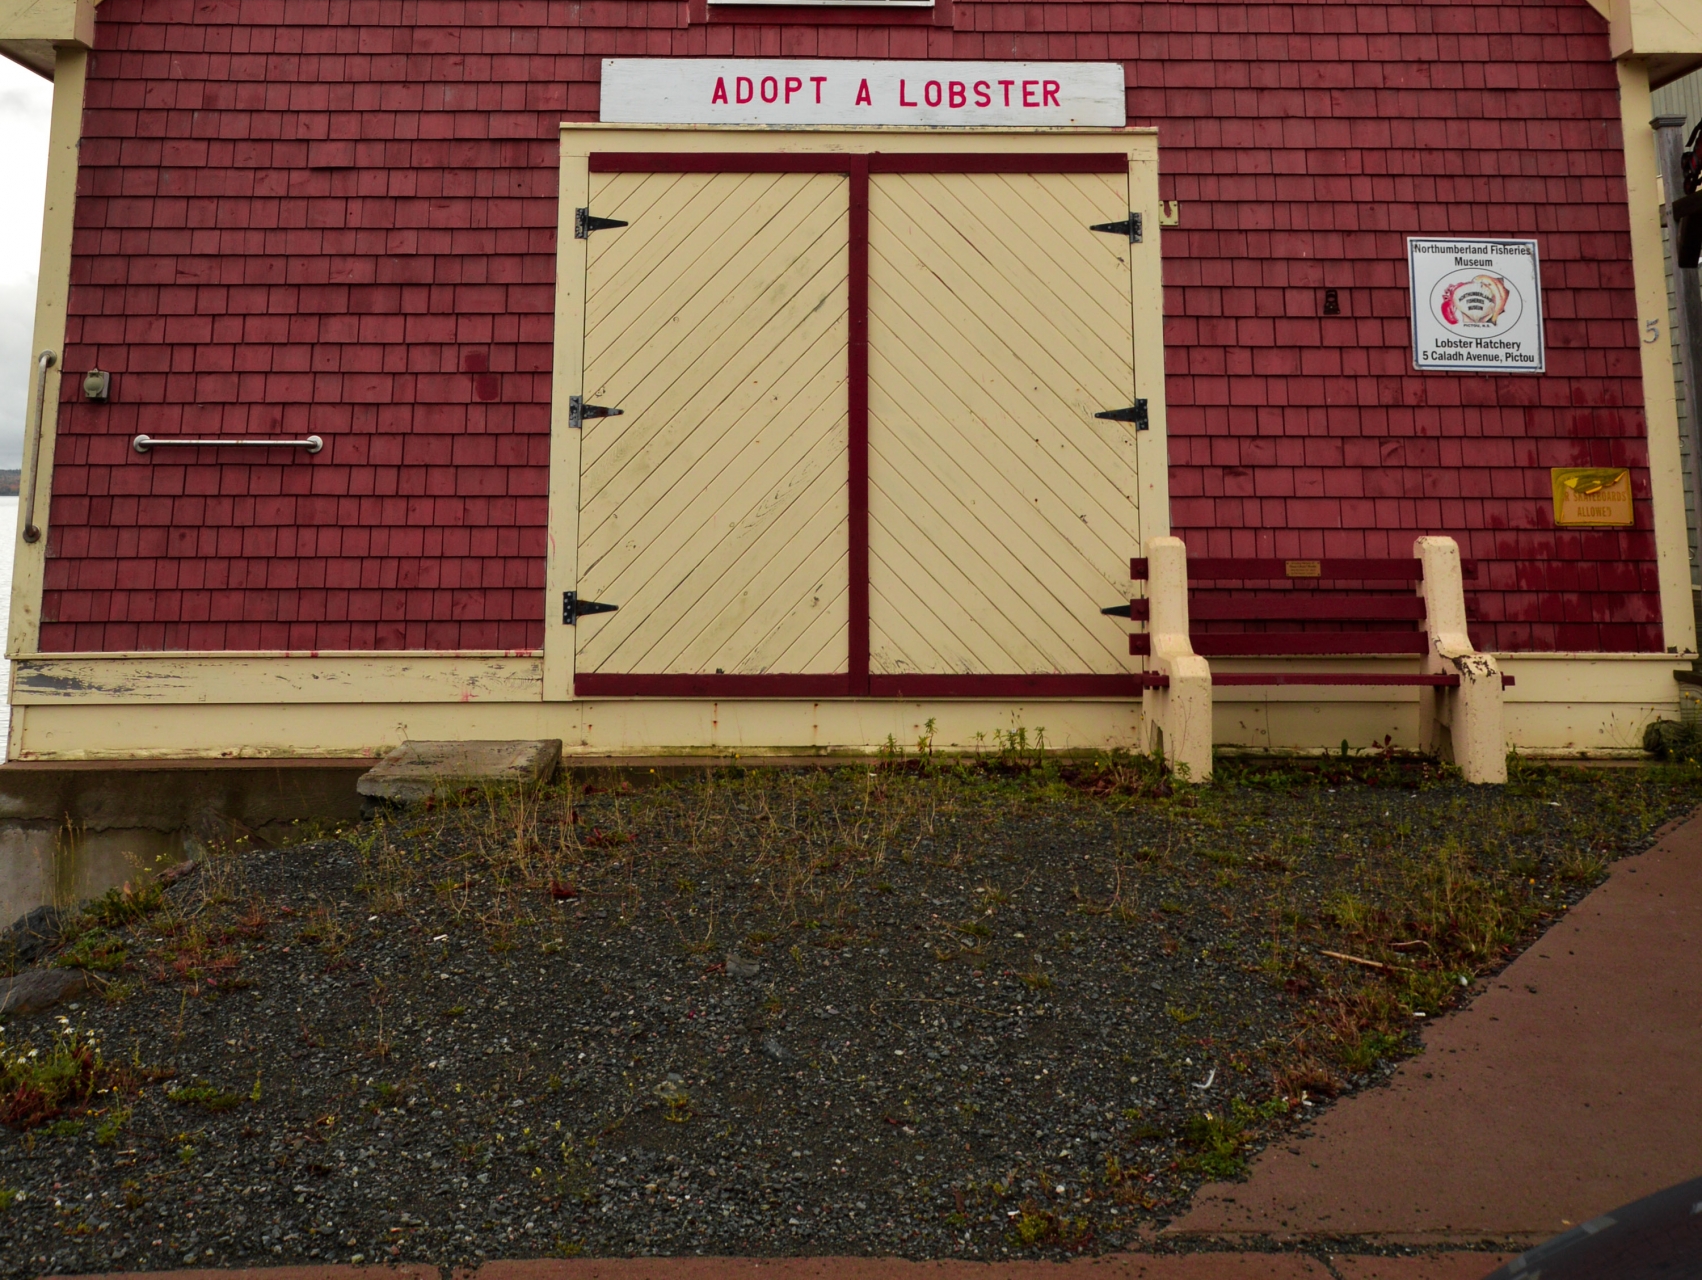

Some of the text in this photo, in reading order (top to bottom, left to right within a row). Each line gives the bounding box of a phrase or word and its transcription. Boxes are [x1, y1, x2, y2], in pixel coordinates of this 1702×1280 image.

[711, 75, 1061, 108] ADOPT A LOBSTER
[1414, 244, 1531, 256] Northumberland Fisheries
[1454, 257, 1493, 267] Museum
[1643, 318, 1660, 344] 5
[1435, 338, 1521, 351] Lobster Hatchery
[1422, 350, 1535, 363] 5 Caladh Avenue, Pictou
[1577, 506, 1612, 517] ALLOWED
